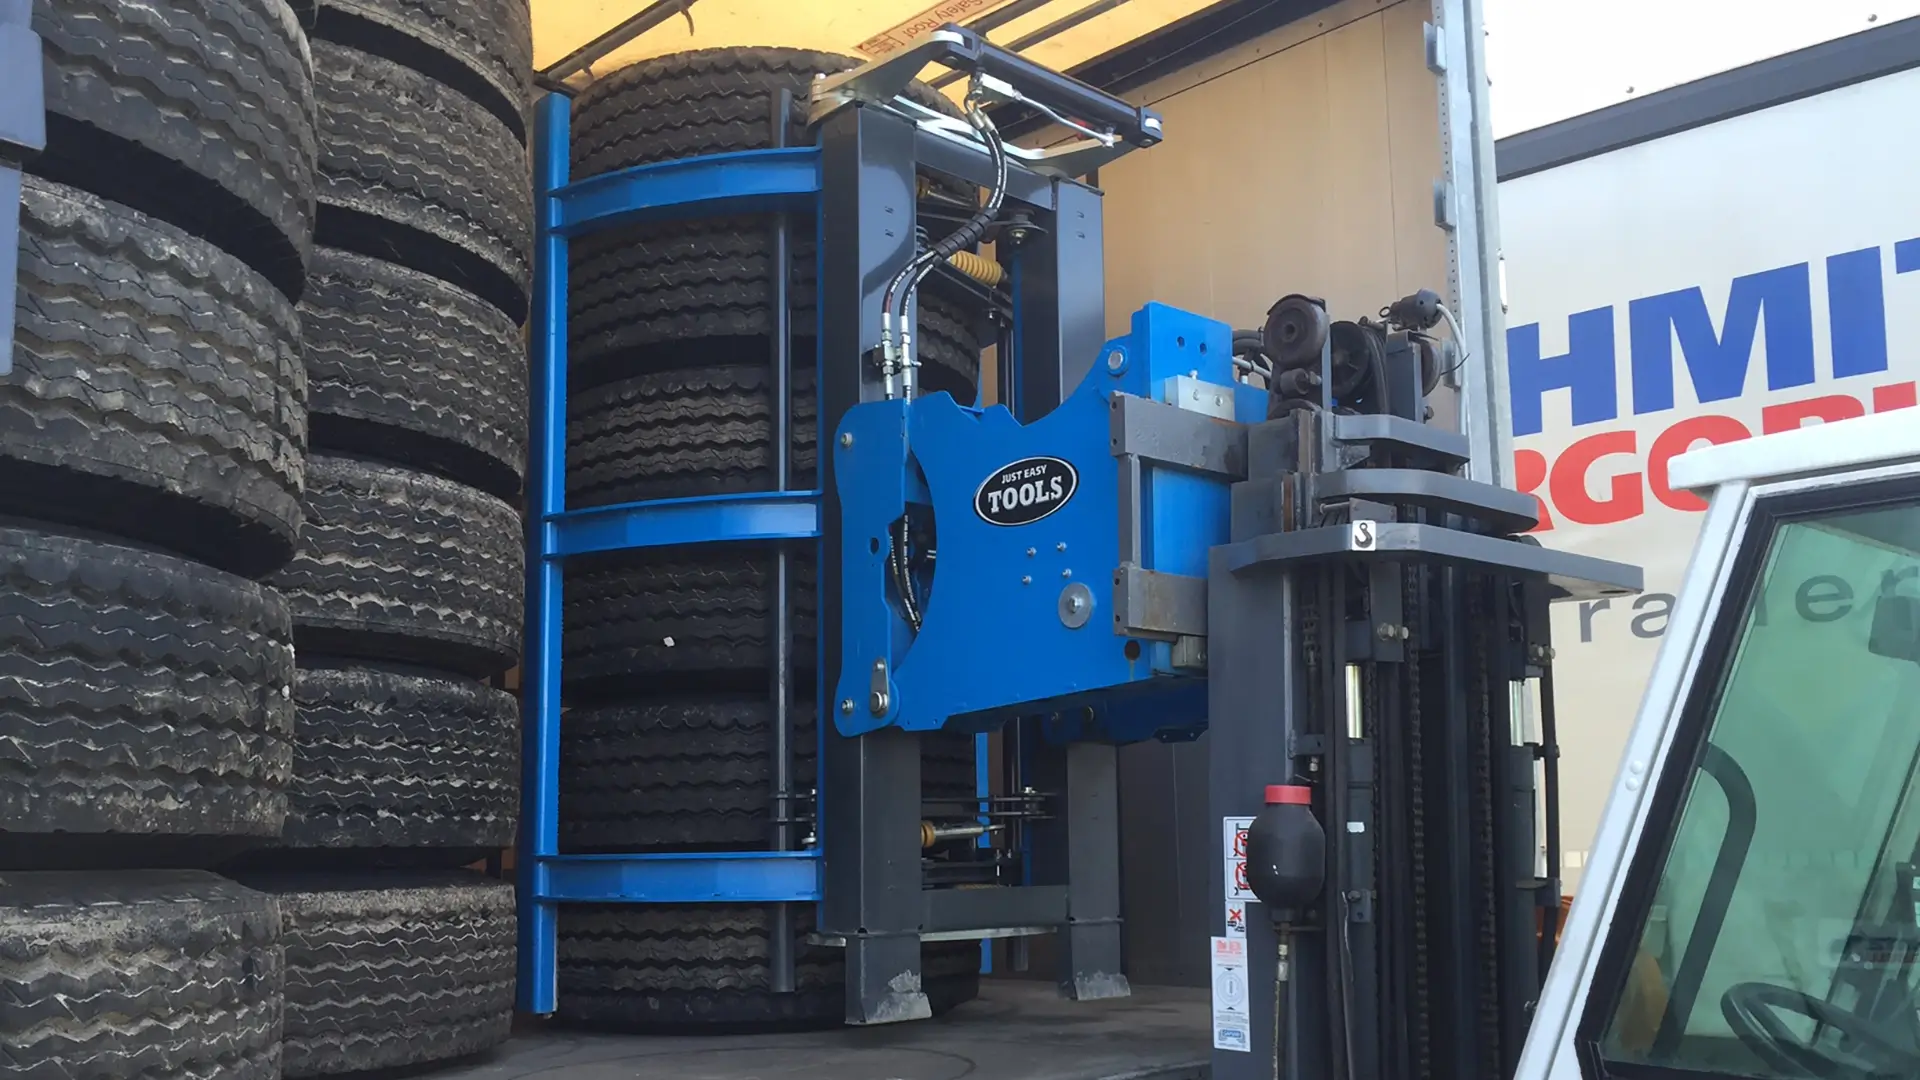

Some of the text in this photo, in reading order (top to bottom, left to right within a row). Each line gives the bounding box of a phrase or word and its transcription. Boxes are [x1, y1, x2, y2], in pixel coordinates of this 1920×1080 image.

[902, 18, 939, 39] Roof
[1001, 464, 1048, 484] JUST EASY
[987, 475, 1063, 514] TOOLS
